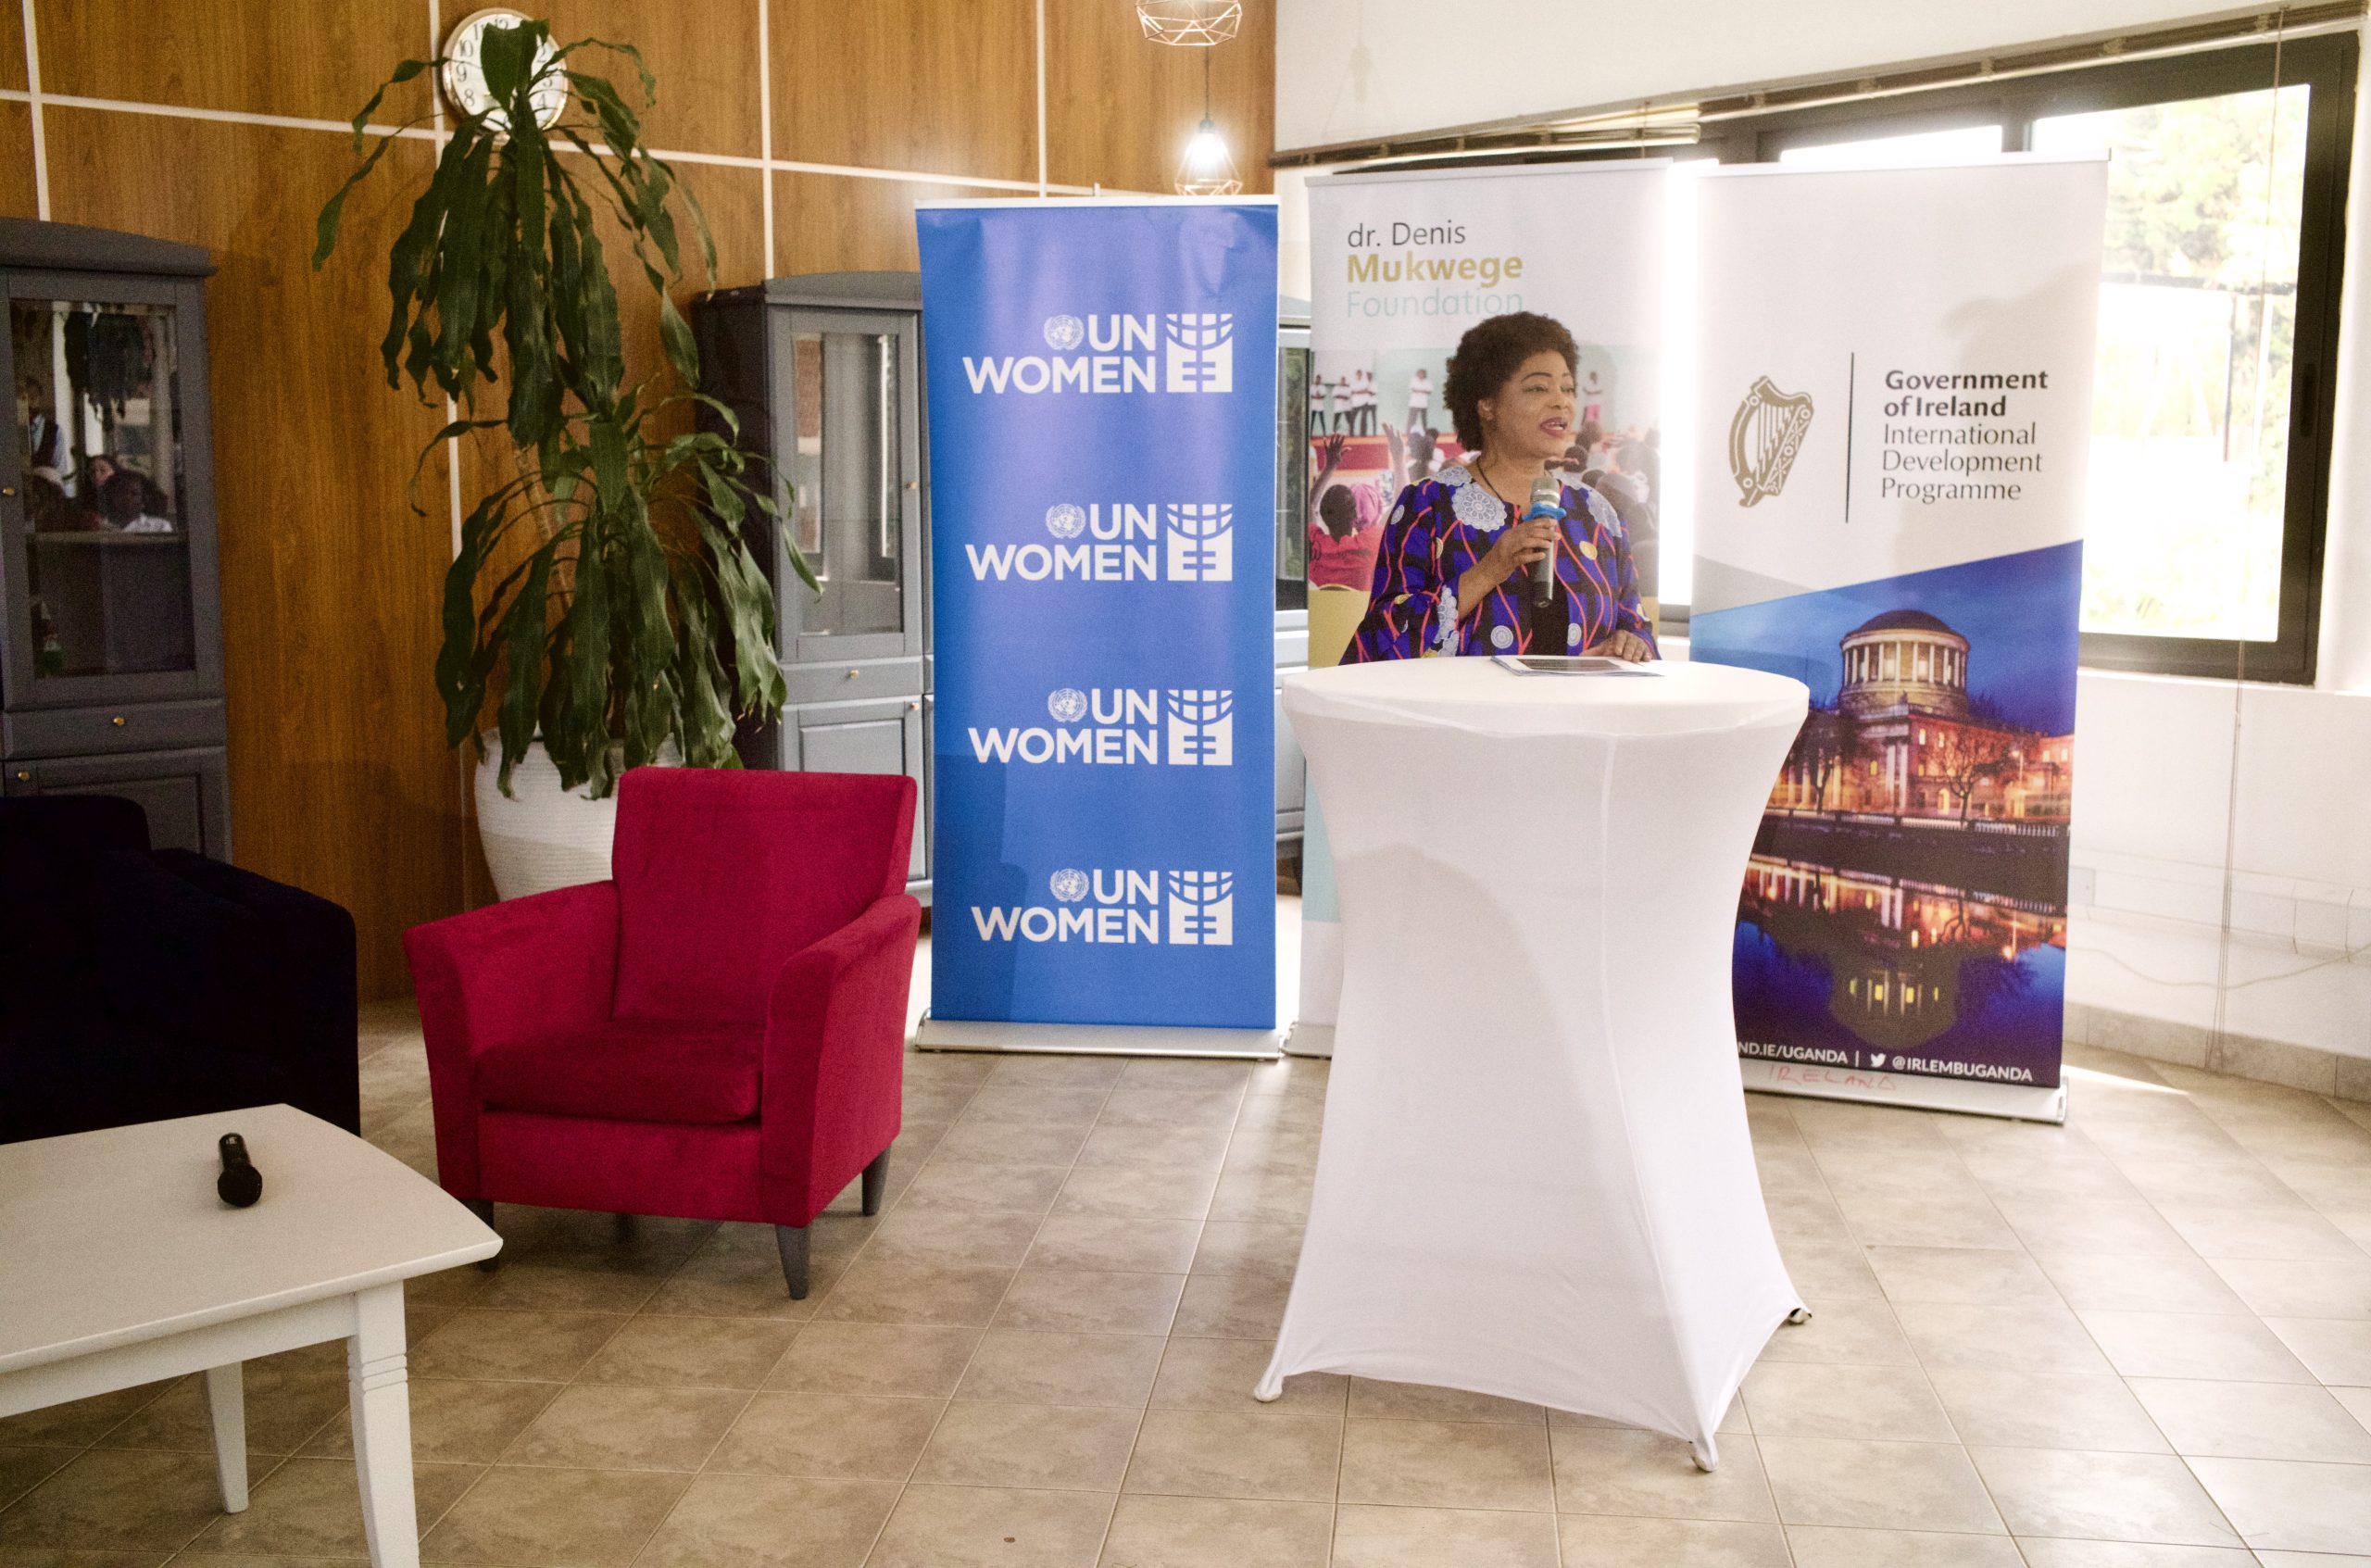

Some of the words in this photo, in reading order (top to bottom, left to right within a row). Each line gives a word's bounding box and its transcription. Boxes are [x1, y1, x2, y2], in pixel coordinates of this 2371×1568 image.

[459, 39, 474, 57] 10
[456, 62, 468, 82] 9
[464, 88, 475, 107] 8
[1348, 222, 1381, 247] dr.
[1392, 219, 1466, 245] Denis
[1348, 250, 1524, 288] Mukwege
[1348, 286, 1524, 318] Foundation
[1087, 313, 1156, 352] UN
[961, 356, 1156, 394] WOMEN
[1885, 370, 2049, 390] Government
[1884, 395, 1913, 417] of
[1915, 395, 2006, 417] Ireland
[1884, 421, 2036, 445] International
[1882, 448, 2042, 477] Development
[1881, 477, 2022, 505] Programme
[1089, 503, 1157, 541] UN
[964, 544, 1157, 581] WOMEN
[1091, 688, 1158, 725] UN
[967, 727, 1158, 765] WOMEN
[1093, 869, 1159, 905] UN
[971, 906, 1159, 945] WOMEN
[1769, 1065, 1897, 1091] IRELAND
[1892, 1055, 2033, 1083] @IRLEMBUGANDA
